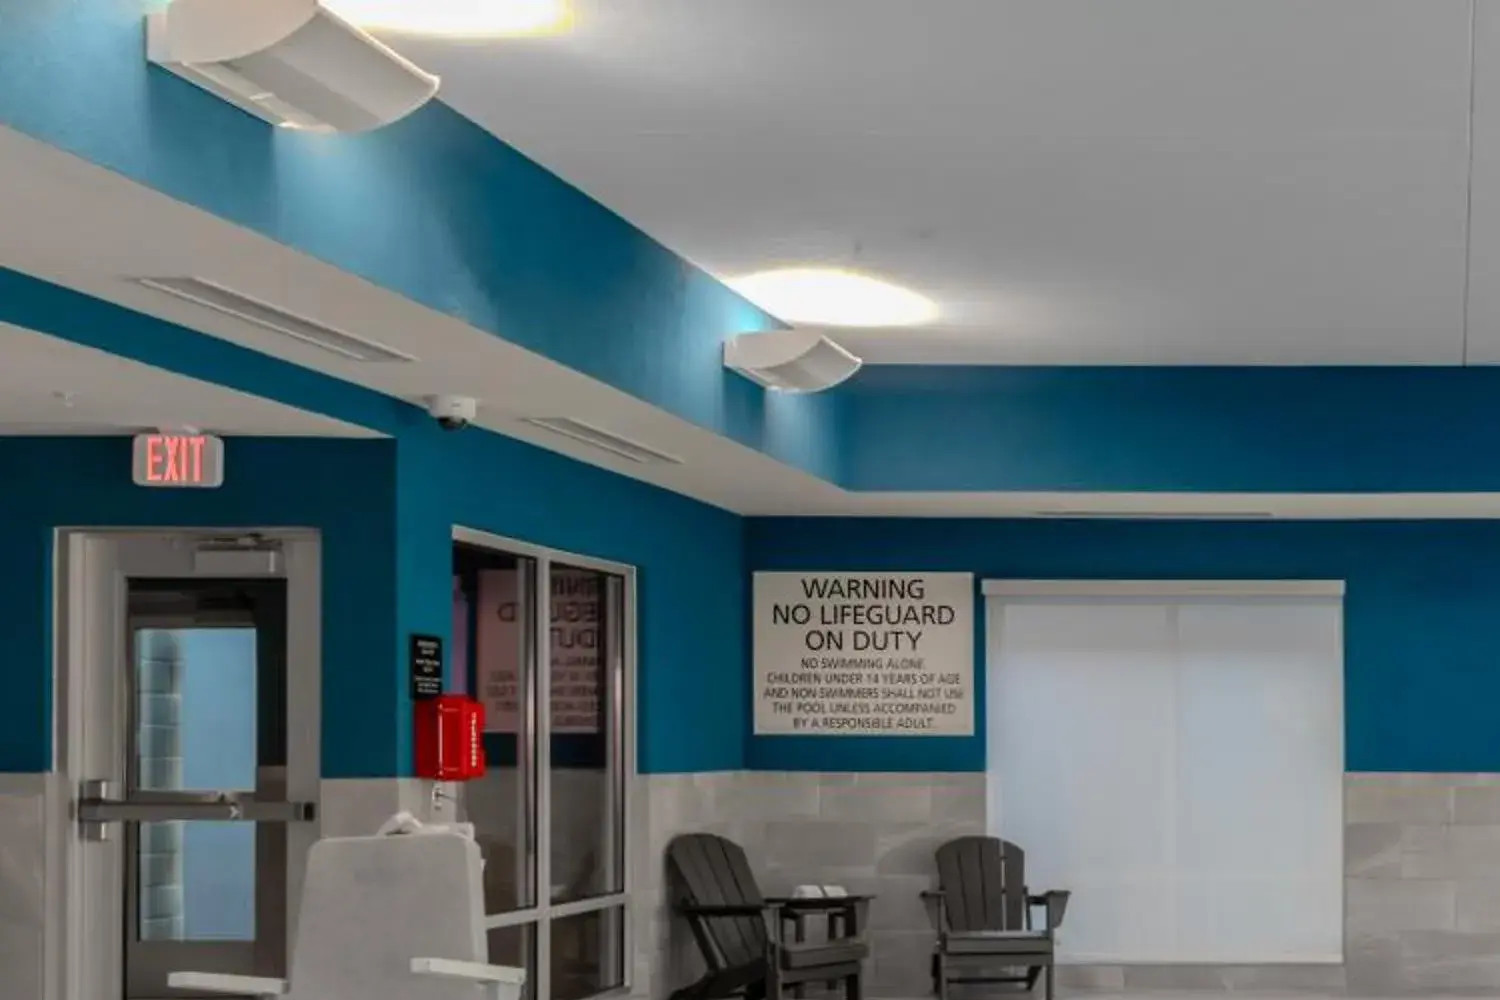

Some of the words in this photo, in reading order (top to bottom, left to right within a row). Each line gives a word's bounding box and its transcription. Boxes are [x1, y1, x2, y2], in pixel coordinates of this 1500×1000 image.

[147, 436, 206, 482] EXIT
[801, 578, 925, 600] WARNING
[773, 604, 811, 625] NO
[820, 604, 956, 625] LIFEGUARD
[805, 629, 844, 651] ON
[853, 630, 923, 651] DUTY
[801, 657, 818, 670] NO
[821, 657, 883, 670] SWIMMING
[766, 672, 821, 685] CHILDREN
[824, 672, 863, 685] UNDER
[763, 687, 789, 700] AND
[772, 701, 792, 715] THE
[796, 702, 826, 715] POOL
